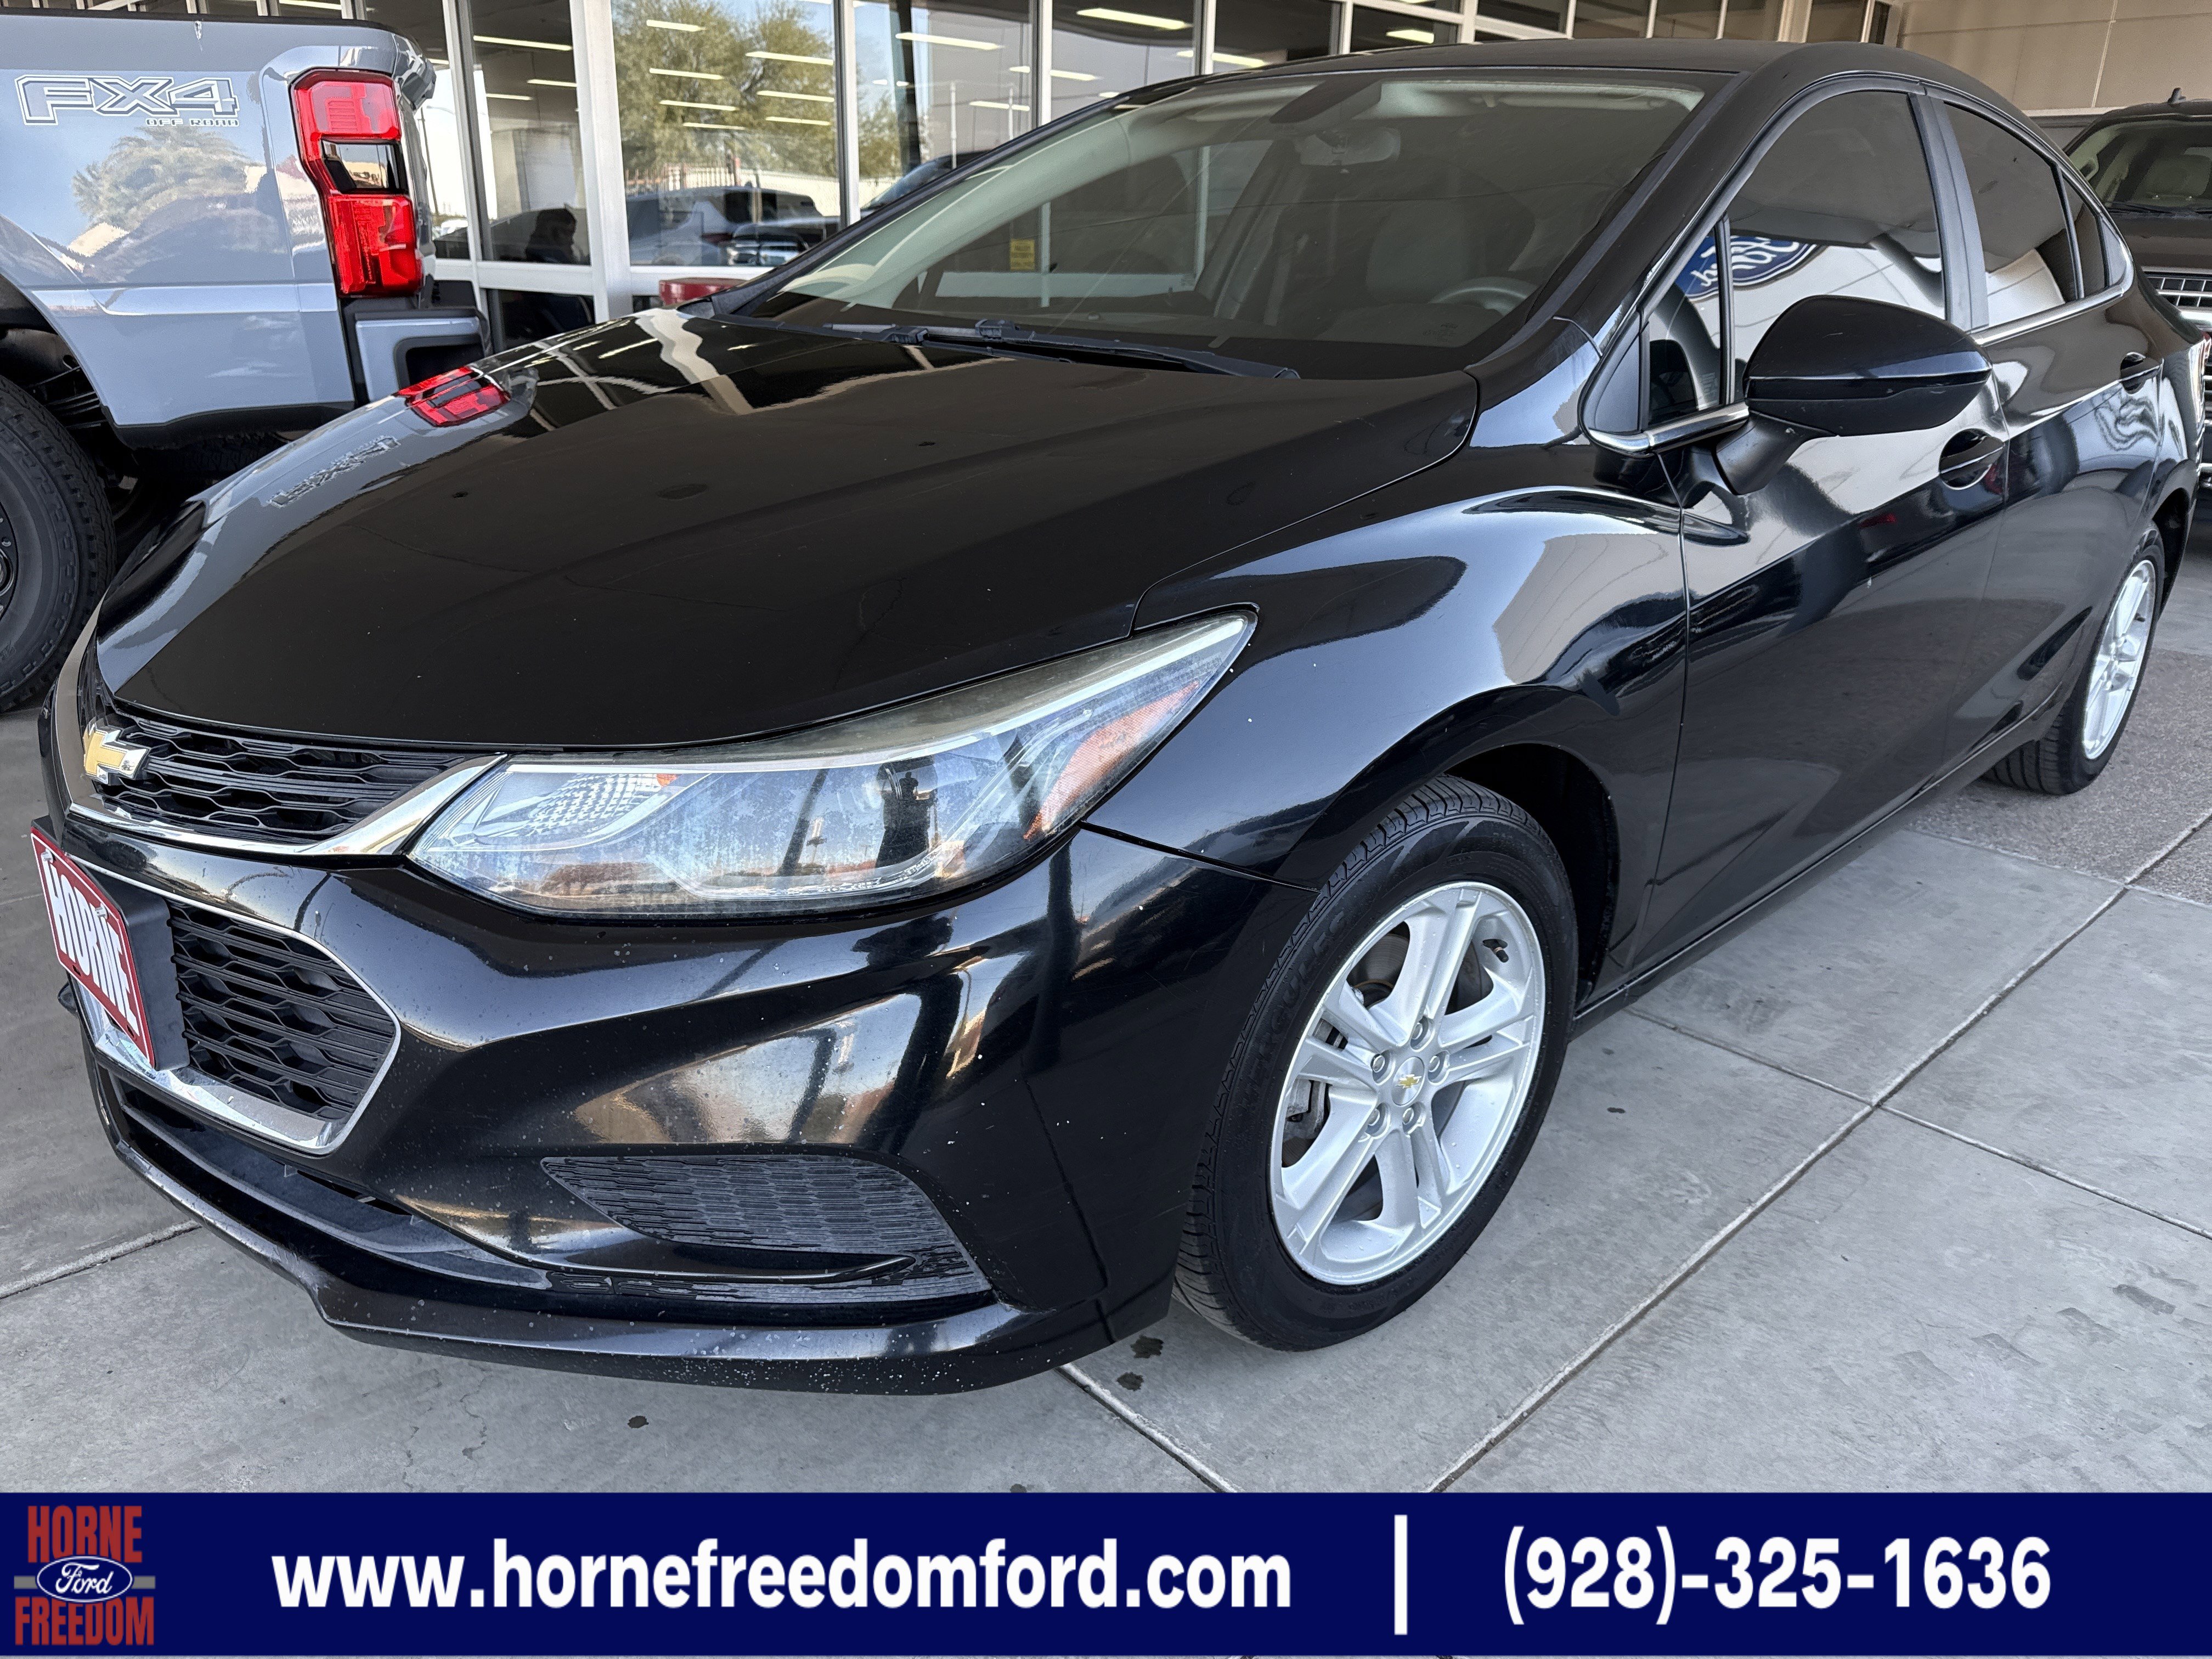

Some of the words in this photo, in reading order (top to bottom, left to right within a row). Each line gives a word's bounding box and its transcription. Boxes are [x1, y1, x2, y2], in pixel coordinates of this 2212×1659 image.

[15, 75, 240, 126] FX4
[190, 119, 240, 127] ROAD
[42, 859, 140, 1037] HORNE
[1239, 910, 1345, 1115] HERCULES
